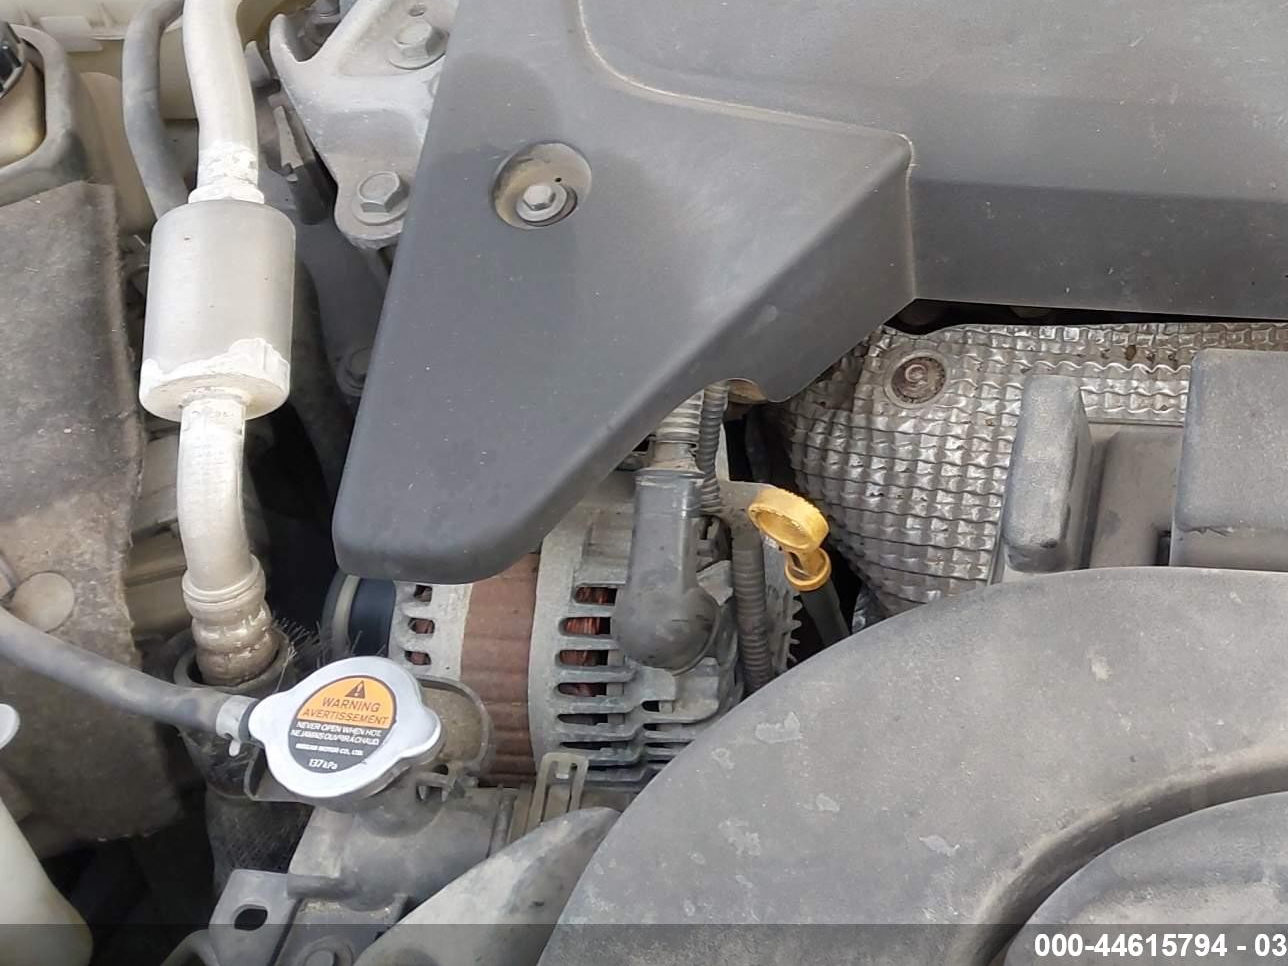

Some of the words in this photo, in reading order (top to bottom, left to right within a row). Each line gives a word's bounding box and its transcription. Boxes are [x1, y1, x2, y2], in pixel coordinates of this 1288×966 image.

[322, 697, 381, 713] WARNING
[302, 708, 389, 724] AVERTISSEMENT
[296, 721, 319, 730] NEVER
[320, 723, 340, 732] OPEN
[342, 726, 364, 735] WHEN
